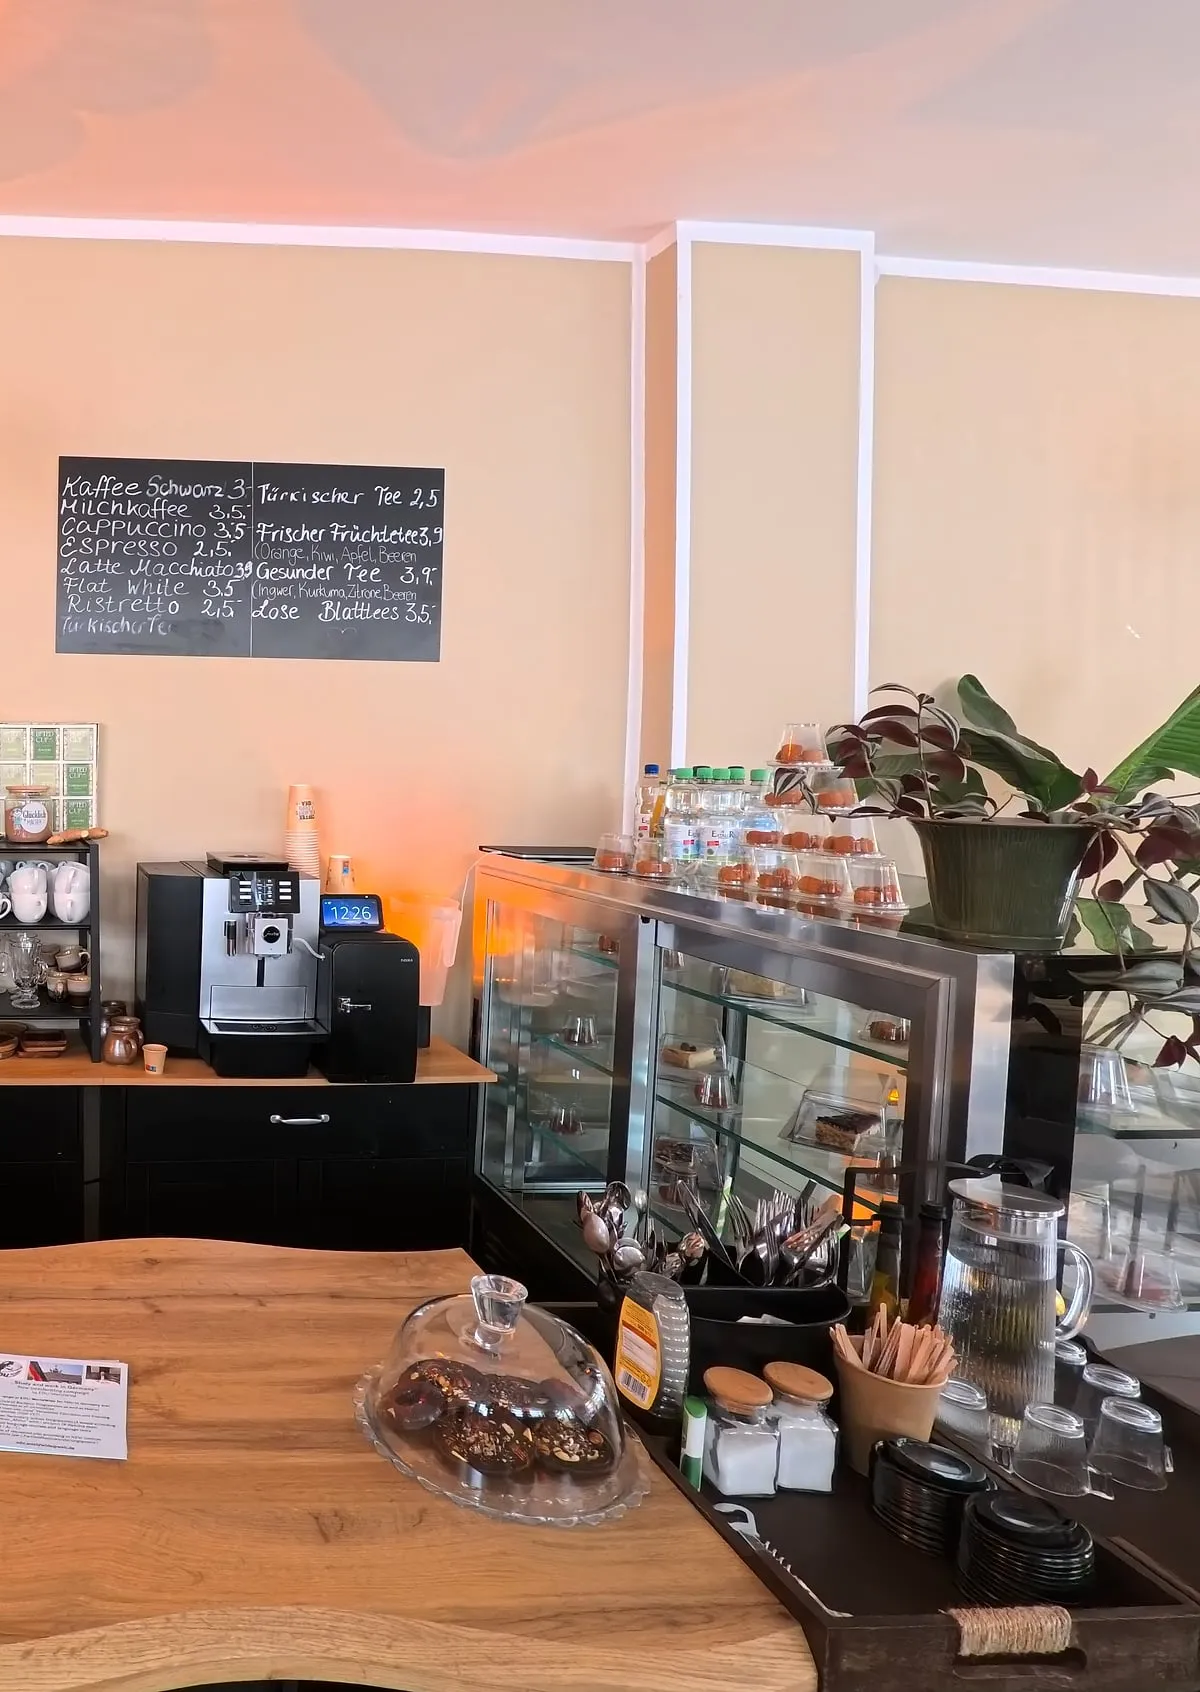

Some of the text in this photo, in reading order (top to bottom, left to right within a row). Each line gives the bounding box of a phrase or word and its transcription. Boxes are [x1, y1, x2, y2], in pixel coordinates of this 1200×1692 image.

[62, 475, 142, 499] Kaffee
[146, 475, 224, 498] Schwarz
[258, 483, 441, 509] Türkischer Tee 2,5
[62, 516, 206, 538] Cappuccino
[256, 522, 326, 543] Frischer
[418, 526, 443, 547] 3,9
[60, 536, 178, 557] Espresso
[379, 545, 417, 564] Beeren
[60, 557, 125, 577] Latte
[130, 557, 234, 578] Macchiato
[256, 561, 334, 581] Gesunder
[344, 563, 382, 583] Tee
[64, 577, 113, 594] Flat
[67, 593, 180, 614] Ristretto
[251, 599, 300, 620] Lose
